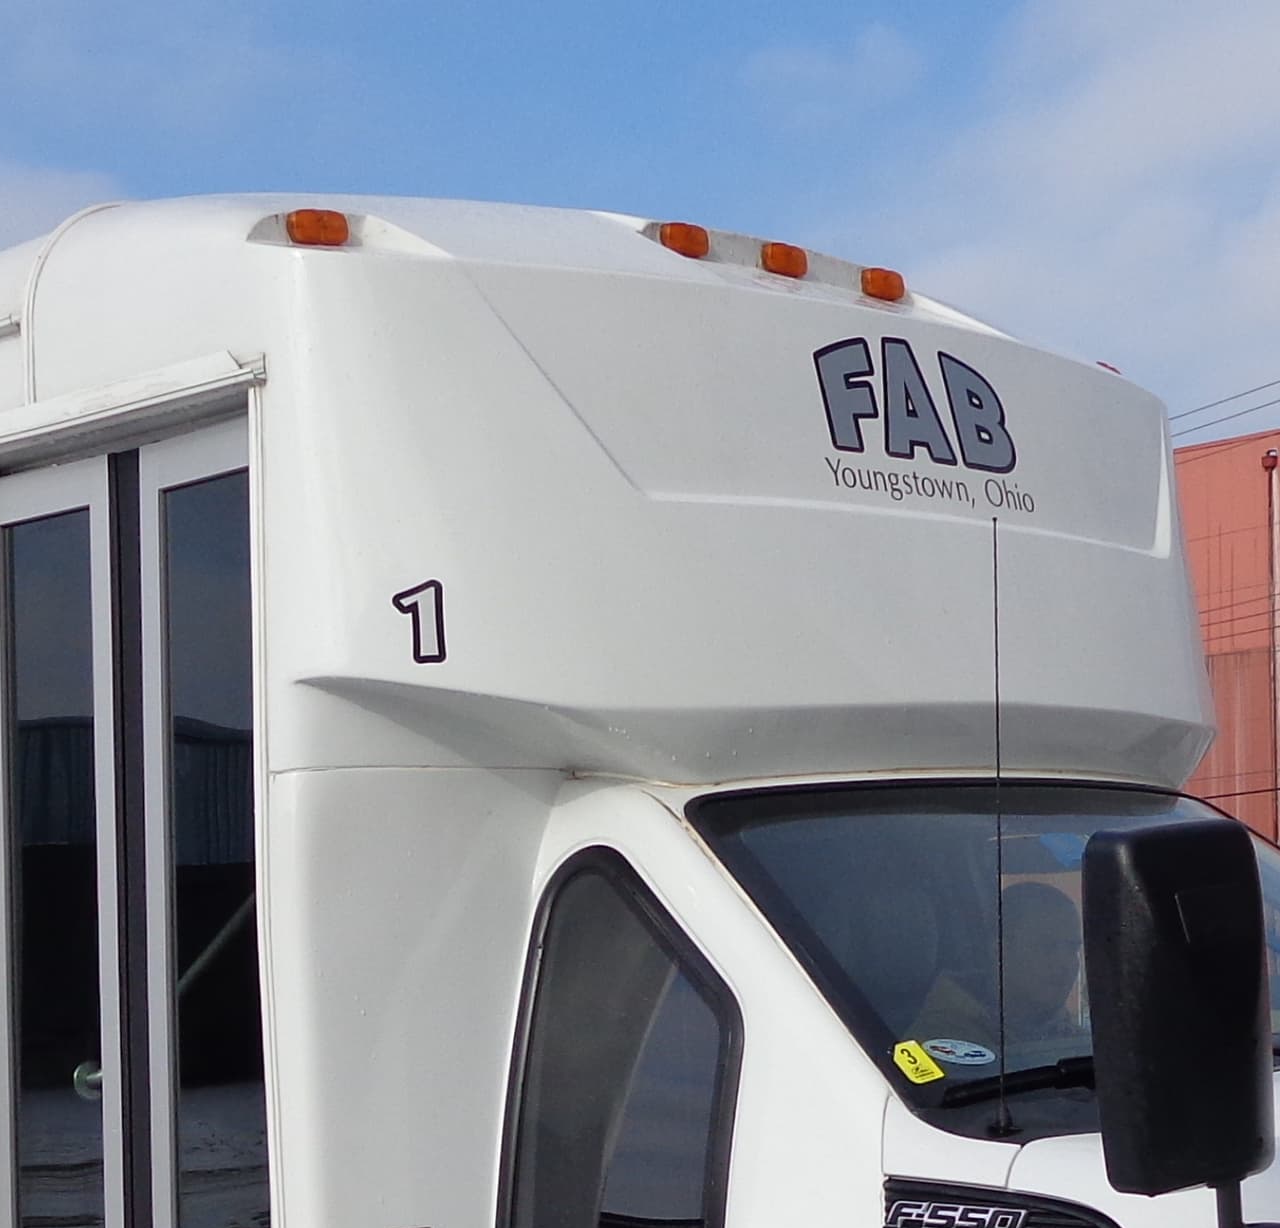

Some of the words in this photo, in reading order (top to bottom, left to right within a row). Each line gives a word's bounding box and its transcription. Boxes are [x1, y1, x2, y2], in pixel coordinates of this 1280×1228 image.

[813, 336, 1017, 474] FAB
[825, 456, 975, 509] Youngstown,
[984, 478, 1035, 513] Ohio
[391, 579, 446, 664] 1
[900, 1048, 918, 1065] 3
